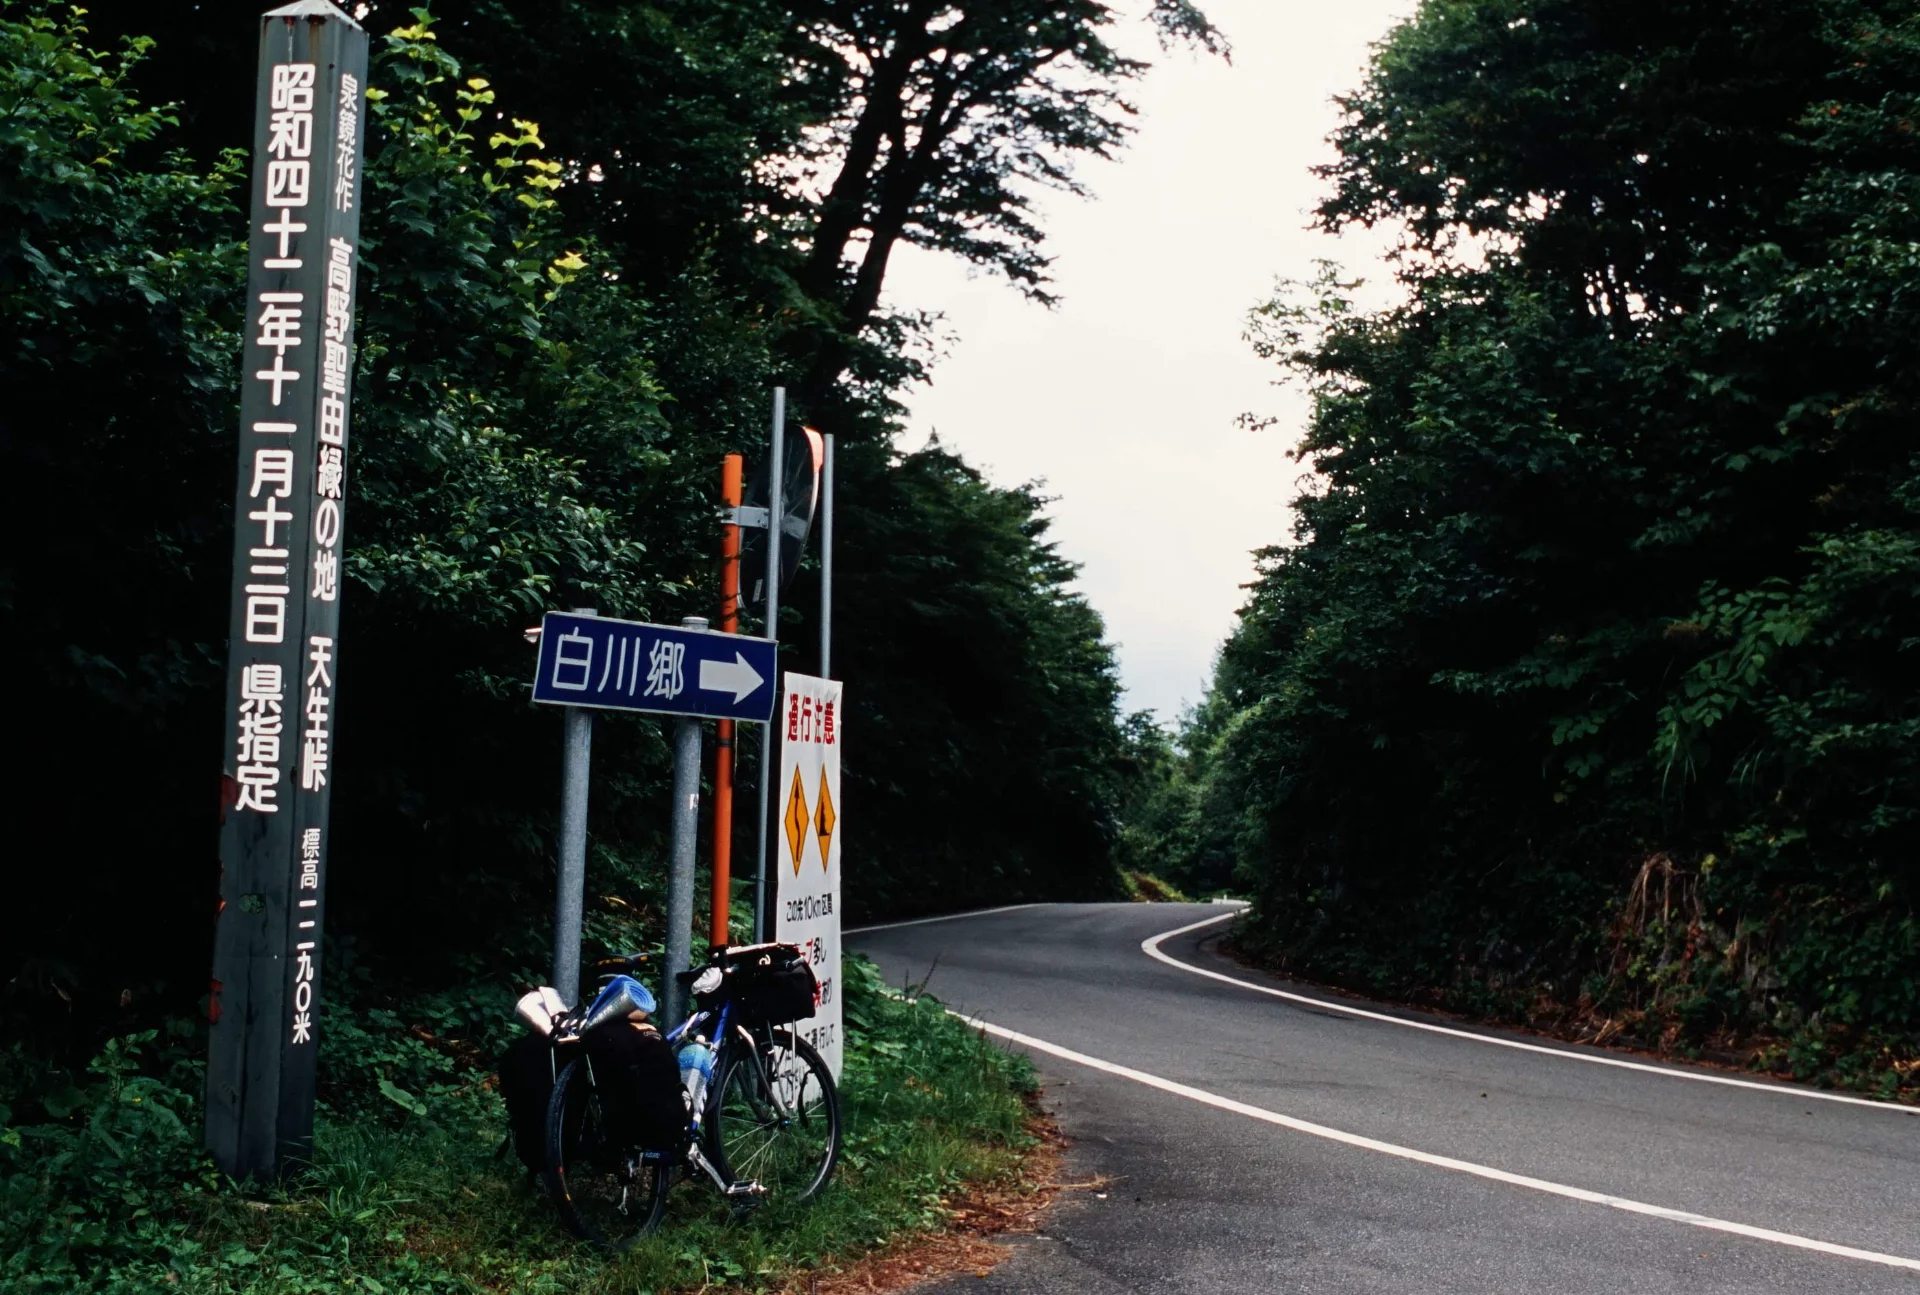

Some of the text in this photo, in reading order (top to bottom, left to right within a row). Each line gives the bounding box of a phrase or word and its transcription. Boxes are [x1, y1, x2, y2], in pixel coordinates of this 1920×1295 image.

[301, 635, 334, 793] 天生峠
[551, 626, 686, 701] 白川郷
[787, 692, 836, 745] 通行注意
[234, 663, 285, 813] 県指定
